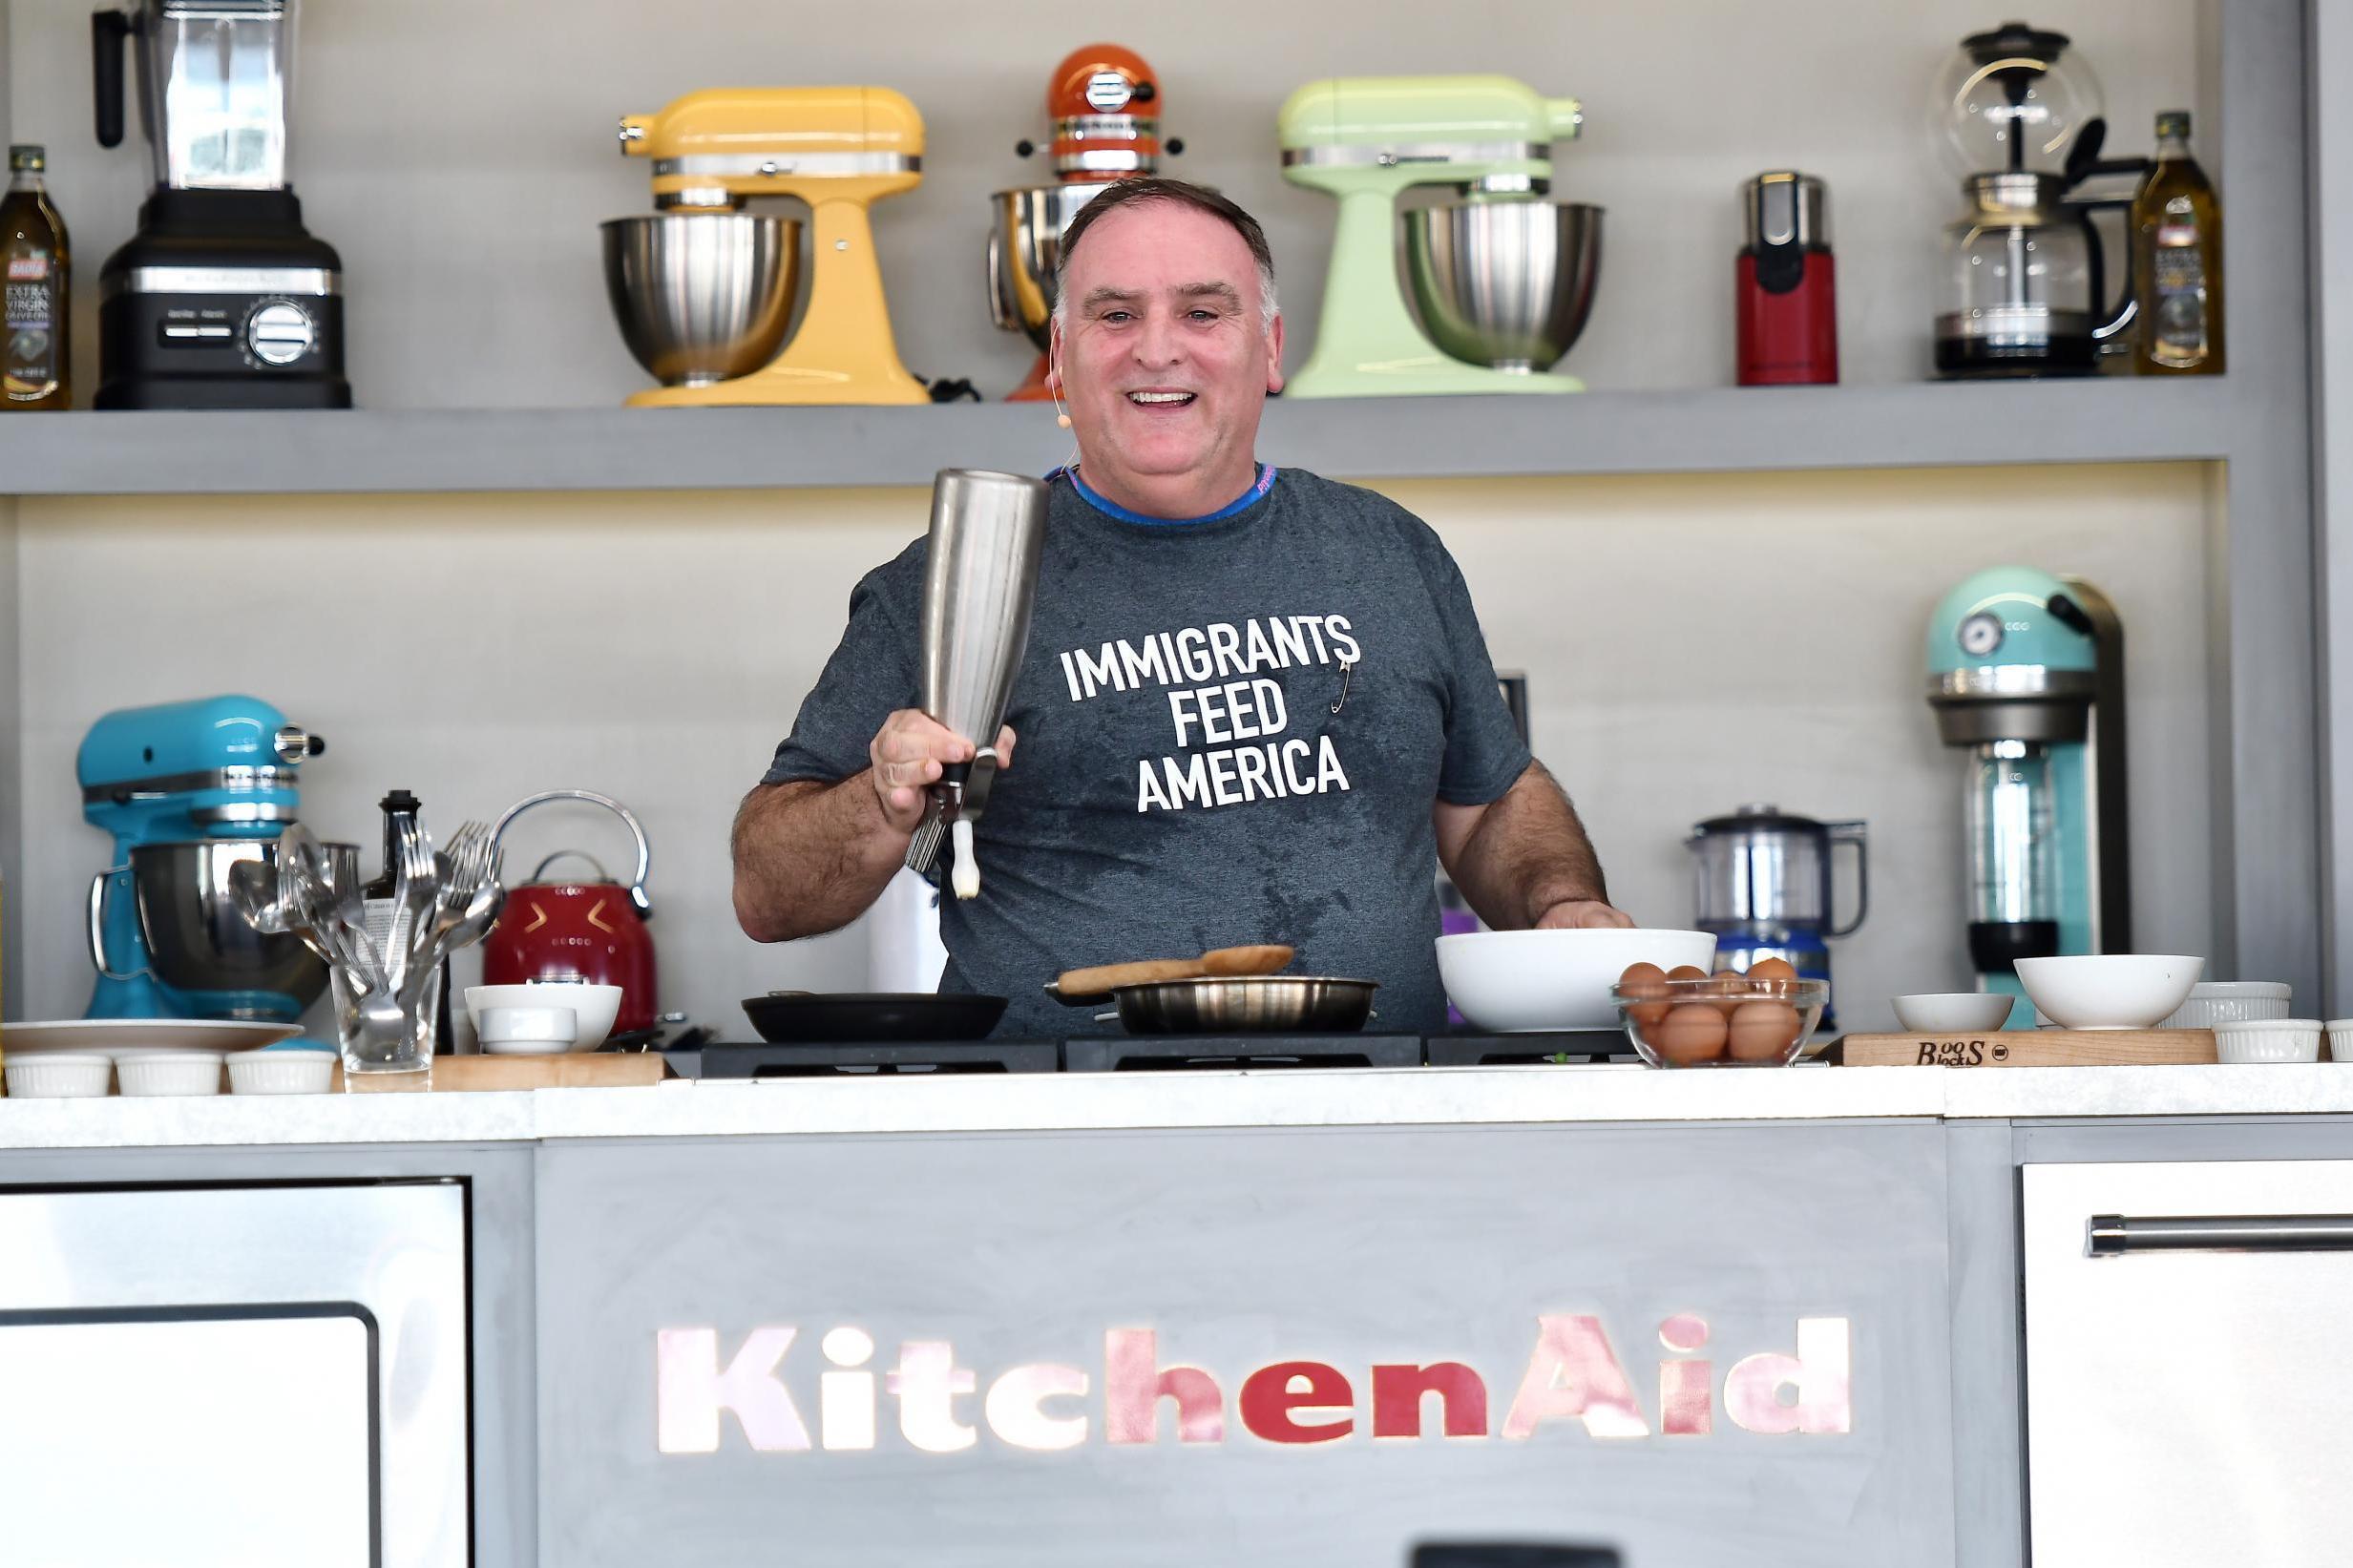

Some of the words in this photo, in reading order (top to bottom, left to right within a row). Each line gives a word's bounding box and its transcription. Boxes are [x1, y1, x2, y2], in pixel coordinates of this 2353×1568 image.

[1060, 614, 1361, 702] IMMIGRANTS
[1167, 678, 1288, 747] FEED
[1137, 735, 1351, 813] AMERICA
[657, 1313, 1851, 1453] KitchenAid
